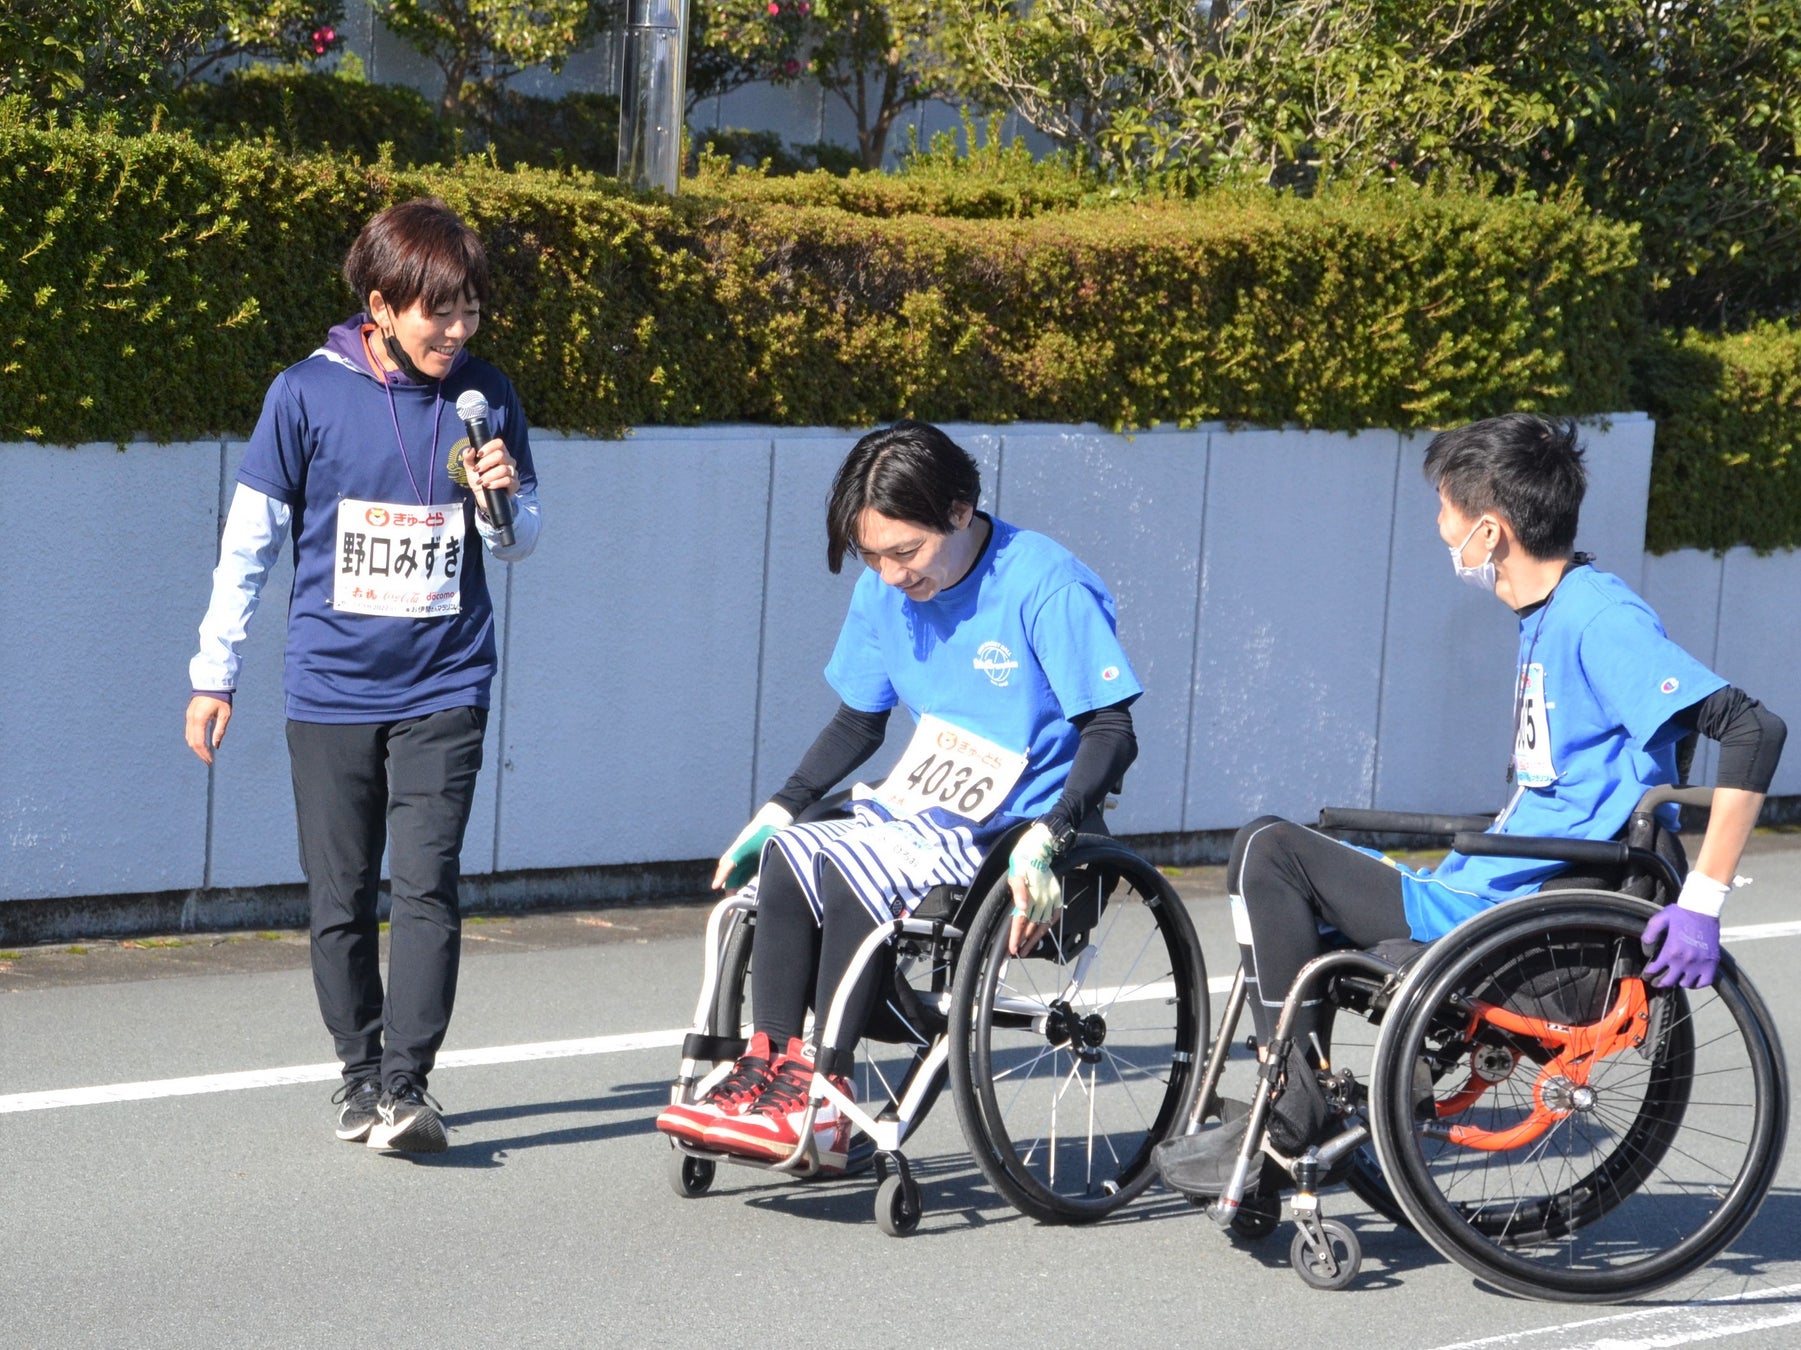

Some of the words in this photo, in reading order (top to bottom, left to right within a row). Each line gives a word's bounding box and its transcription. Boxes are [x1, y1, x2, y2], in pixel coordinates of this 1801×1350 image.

[393, 511, 445, 527] ぎゅーとら
[341, 531, 461, 580] 野口みずき
[426, 591, 455, 601] docomo
[906, 753, 994, 813] 4036
